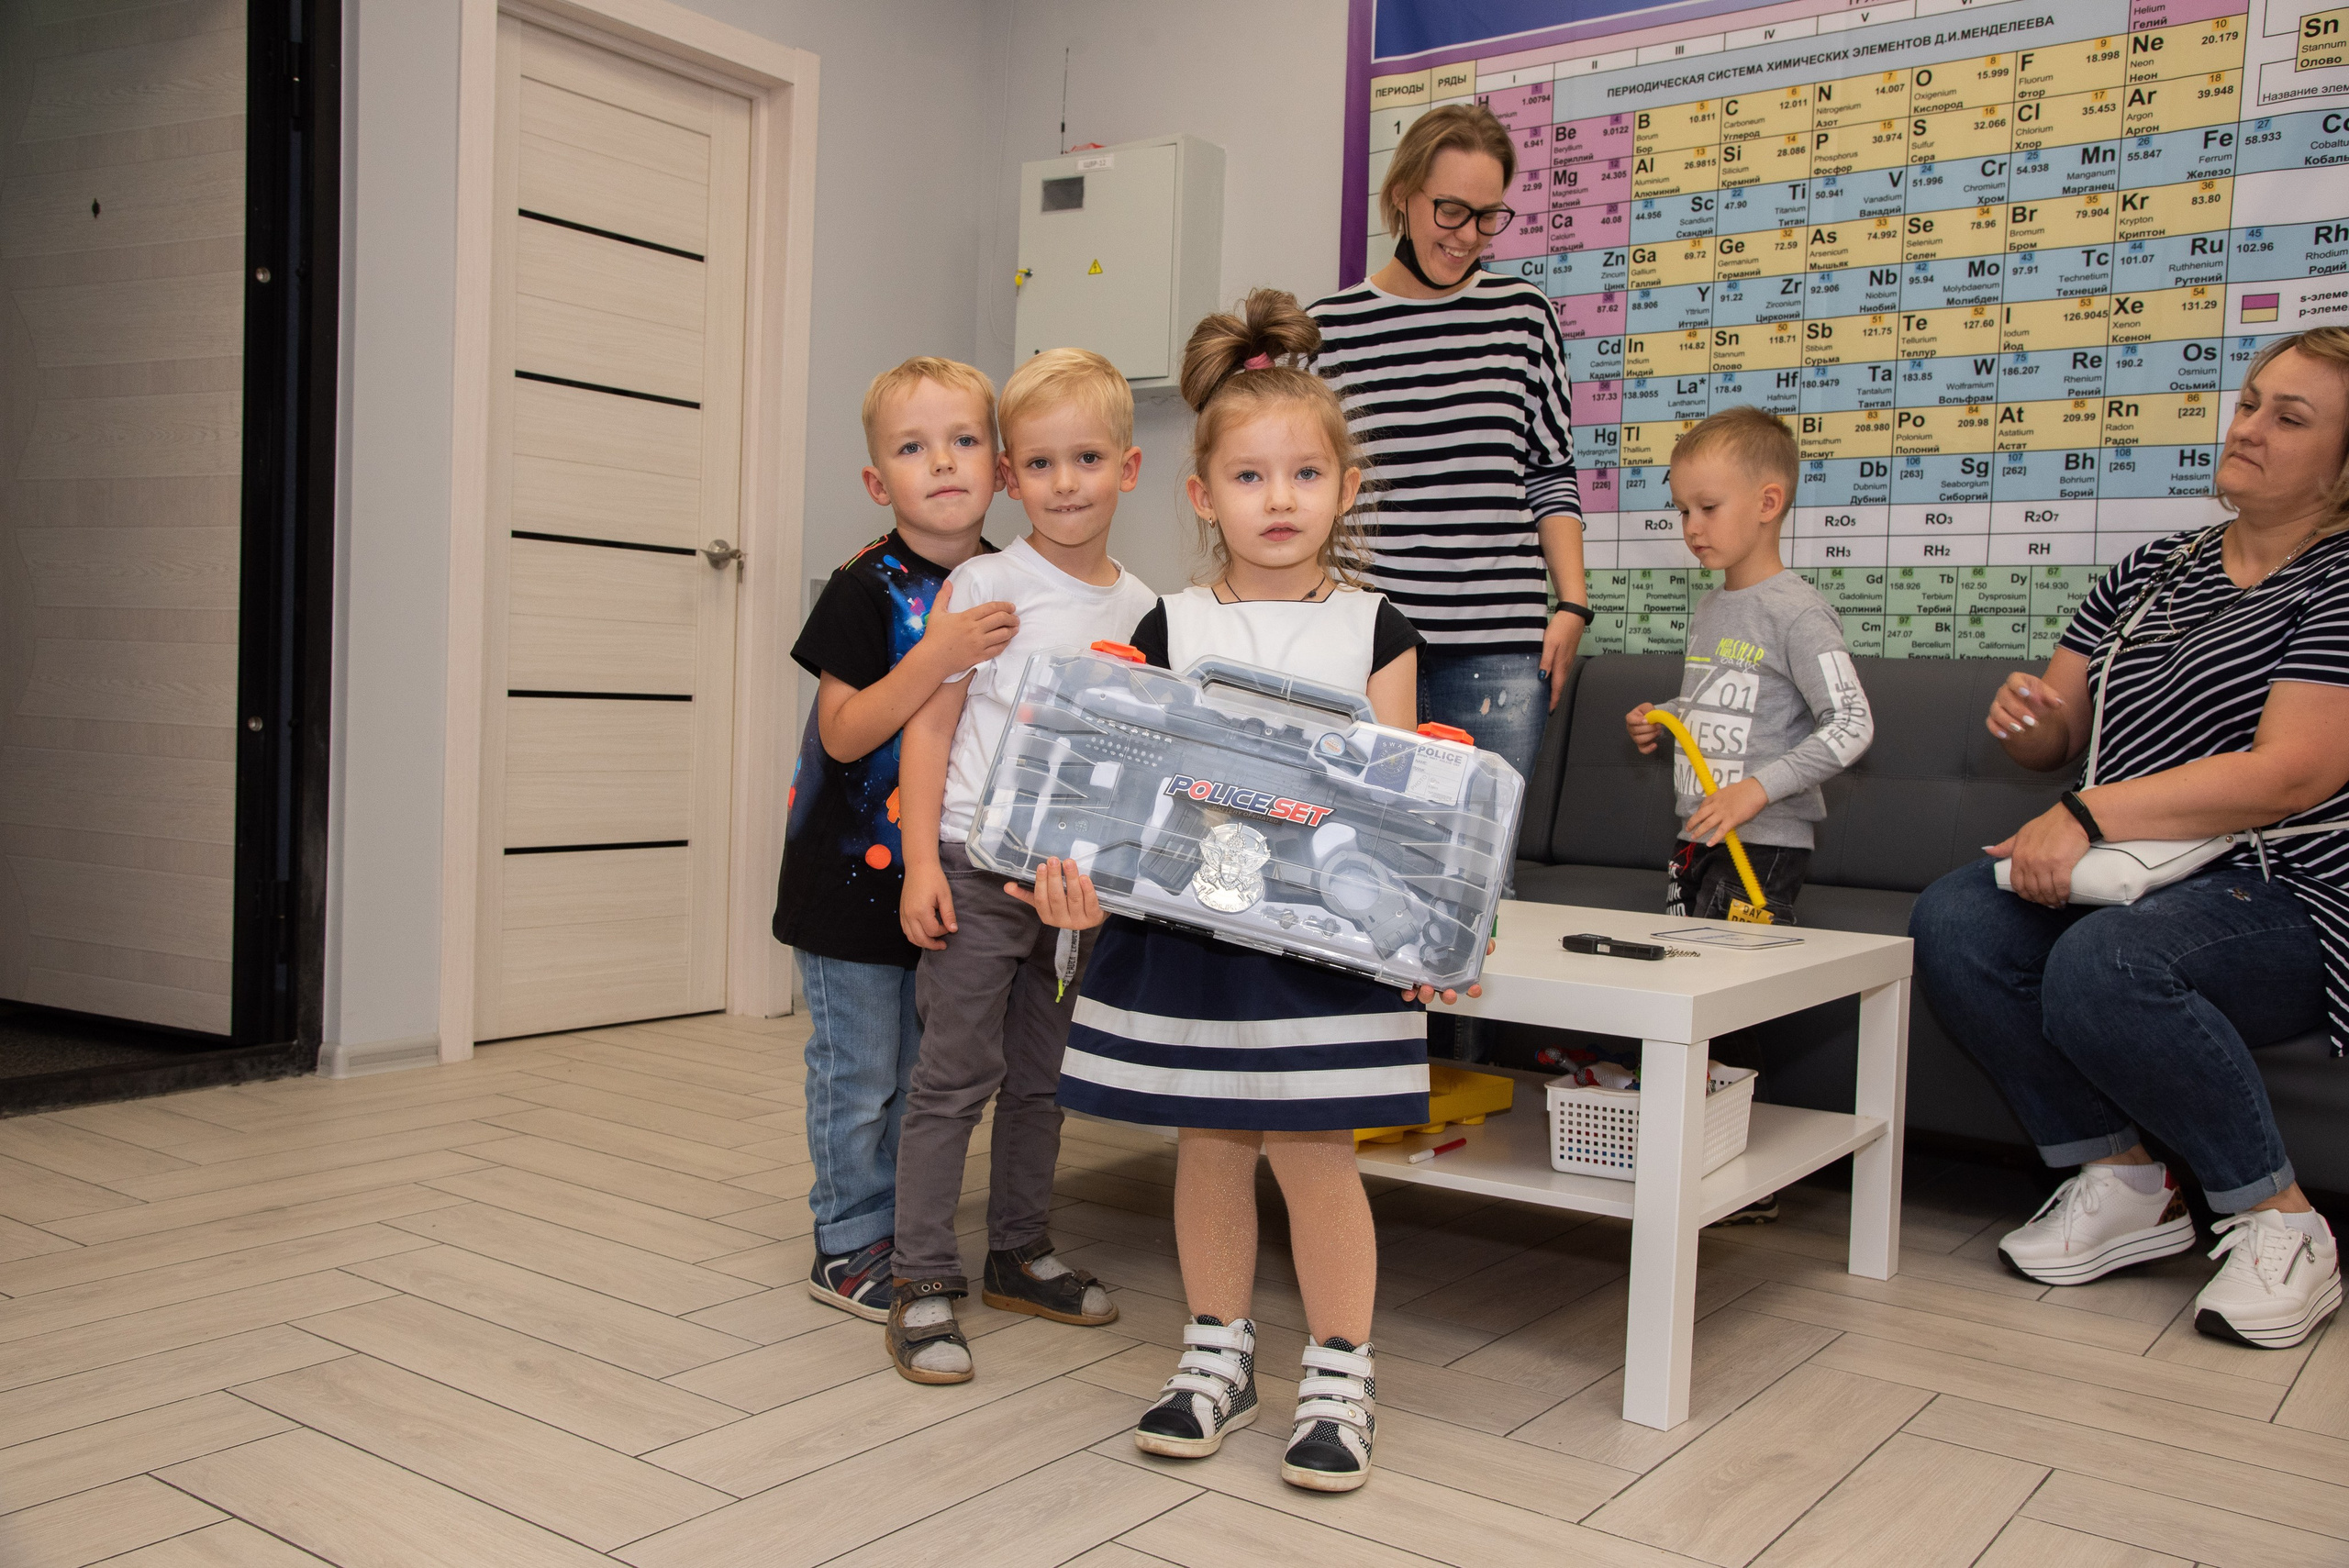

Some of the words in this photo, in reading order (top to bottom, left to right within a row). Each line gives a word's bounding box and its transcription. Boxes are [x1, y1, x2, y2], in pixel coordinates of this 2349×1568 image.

[1861, 13, 1869, 22] V
[2132, 17, 2167, 29] Гелий
[2215, 19, 2226, 28] 10
[1765, 29, 1775, 39] IV
[2303, 18, 2338, 38] Sn
[2132, 35, 2164, 54] Ne
[2201, 31, 2239, 45] 20.179
[1675, 46, 1684, 55] III
[2301, 40, 2346, 53] Stannum
[1607, 72, 1705, 98] ПЕРИОДИЧЕСКАЯ
[1708, 60, 1763, 81] СИСТЕМА
[1766, 50, 1849, 73] ХИМИЧЕСКИХ
[1853, 35, 1932, 58] ЭЛЕМЕНТОВ
[1933, 15, 2054, 45] Д.И.МЕНДЕЛЕЕВА
[2021, 53, 2034, 72] F
[2087, 50, 2120, 62] 18.998
[2299, 57, 2342, 68] Олово
[1916, 70, 1932, 86] O
[1977, 68, 2009, 79] 15.999
[2129, 72, 2158, 83] Неон
[1438, 75, 1466, 87] РЯДЫ
[1376, 83, 1424, 97] ПЕРИОДЫ
[1819, 84, 1831, 103] N
[1876, 83, 1905, 95] 14.007
[2198, 85, 2233, 99] 39.948
[2263, 86, 2318, 102] Название
[1780, 99, 1807, 109] 12.011
[2127, 88, 2157, 107] Ar
[1725, 99, 1738, 116] C
[1913, 101, 1964, 114] Кислород
[2017, 103, 2040, 122] Cl
[2083, 103, 2116, 116] 35.453
[1395, 121, 1400, 134] 1
[1912, 119, 1927, 136] S
[1974, 118, 2006, 130] 32.066
[2125, 124, 2160, 137] Аргон
[2257, 119, 2270, 128] 27
[1555, 127, 1576, 141] Be
[2204, 129, 2233, 149] Fe
[2244, 131, 2281, 145] 58.933
[1816, 133, 1829, 150] P
[1723, 145, 1742, 162] Si
[2081, 146, 2116, 165] Mn
[2127, 149, 2162, 161] 55.847
[2199, 154, 2232, 163] Ferrum
[1635, 158, 1653, 174] Al
[1685, 159, 1716, 169] 26.9815
[1980, 160, 2008, 177] Cr
[2017, 163, 2049, 174] 54.938
[1553, 169, 1577, 187] Mg
[1888, 171, 1903, 187] V
[2066, 169, 2116, 180] Manganum
[2187, 168, 2232, 180] Железо
[1523, 183, 1542, 192] 22.99
[1634, 186, 1679, 198] Алюминий
[1787, 183, 1806, 200] Ti
[2202, 181, 2213, 190] 36
[1690, 196, 1714, 213] Sc
[1977, 195, 2005, 206] Хром
[2121, 193, 2149, 212] Kr
[2191, 194, 2221, 206] 83.80
[2011, 206, 2038, 224] Br
[2076, 207, 2109, 218] 79.904
[1552, 214, 1573, 229] Ca
[1908, 217, 1934, 235] Se
[1809, 228, 1837, 245] As
[2248, 228, 2262, 239] 45
[2314, 224, 2349, 245] Rh
[1720, 239, 1745, 255] Ge
[2191, 237, 2223, 256] Ru
[2237, 242, 2274, 253] 102.96
[1602, 251, 1625, 267] Zn
[1632, 248, 1656, 264] Ga
[2081, 250, 2109, 267] Tc
[2121, 254, 2154, 265] 101.07
[2305, 250, 2348, 261] Rhodium
[1967, 259, 2000, 277] Mo
[2309, 261, 2347, 274] Родий
[1870, 268, 1898, 286] Nb
[1780, 278, 1802, 295] Zr
[1698, 286, 1710, 302] Y
[2113, 297, 2143, 316] Xe
[2182, 300, 2217, 310] 131.29
[2064, 310, 2109, 321] 126.9045
[1903, 315, 1927, 331] Te
[1807, 323, 1832, 339] Sb
[1714, 330, 1739, 347] Sn
[2112, 334, 2151, 343] Ксенон
[1598, 339, 1620, 356] Cd
[2183, 343, 2217, 361] Os
[1973, 358, 1995, 376] W
[2072, 352, 2102, 369] Re
[2116, 359, 2143, 369] 190.2
[1868, 365, 1892, 382] Ta
[2002, 365, 2040, 376] 186.207
[1776, 371, 1798, 389] Hf
[2169, 380, 2216, 391] Осьмий
[1939, 395, 1993, 406] Вольфрам
[1998, 406, 2024, 424] At
[2108, 400, 2139, 418] Rn
[2178, 407, 2206, 418] [222]
[1803, 417, 1822, 433] Bi
[1898, 412, 1925, 428] Po
[1595, 428, 1617, 446] Hg
[1896, 445, 1940, 453] Полоний
[2115, 448, 2132, 457] 108
[2065, 452, 2094, 470] Bh
[2178, 449, 2210, 467] Hs
[1860, 461, 1887, 477] Db
[1961, 457, 1989, 477] Sg
[2109, 462, 2135, 473] [265]
[1940, 492, 1988, 503] Сиборгий
[2168, 486, 2210, 496] Хассий
[2028, 543, 2050, 554] RH
[1612, 576, 1626, 584] Nd
[1670, 575, 1685, 584] Pm
[1866, 574, 1883, 584] Gd
[1940, 574, 1954, 584] Tb
[2011, 573, 2028, 585] Dy
[1969, 605, 2026, 615] Диспрозий
[1670, 620, 1685, 631] Np
[1862, 622, 1881, 631] Cm
[1935, 622, 1951, 632] Bk
[2011, 623, 2026, 633] Cf
[1719, 683, 1752, 713] 01
[1418, 746, 1463, 764] POLICE
[1167, 774, 1275, 814] POLICE
[1269, 797, 1334, 827] SET
[1743, 906, 1762, 918] DAY
